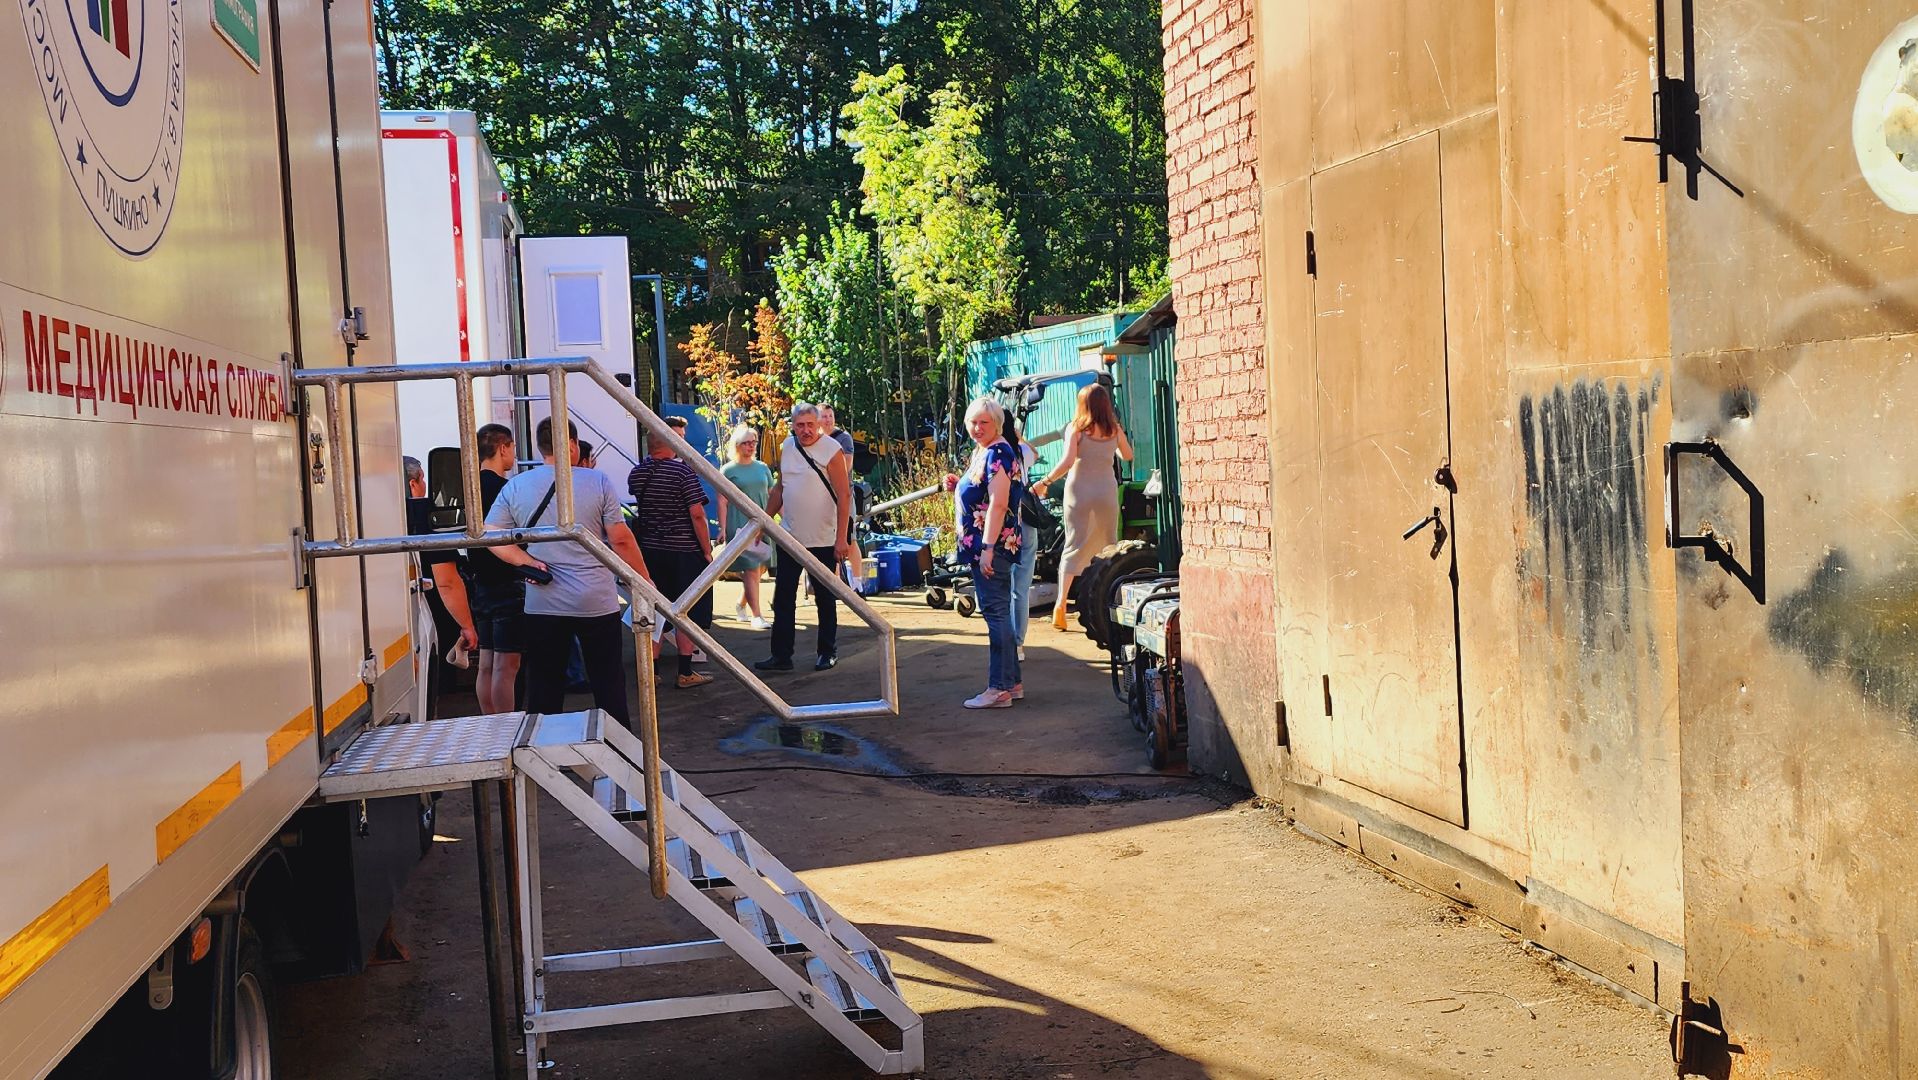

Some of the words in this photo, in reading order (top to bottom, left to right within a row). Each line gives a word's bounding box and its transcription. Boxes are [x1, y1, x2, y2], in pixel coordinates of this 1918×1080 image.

[96, 167, 149, 232] ПУШКИНО
[22, 310, 221, 420] МЕДИЦИНСКАЯ
[225, 362, 287, 424] СЛУЖБА
